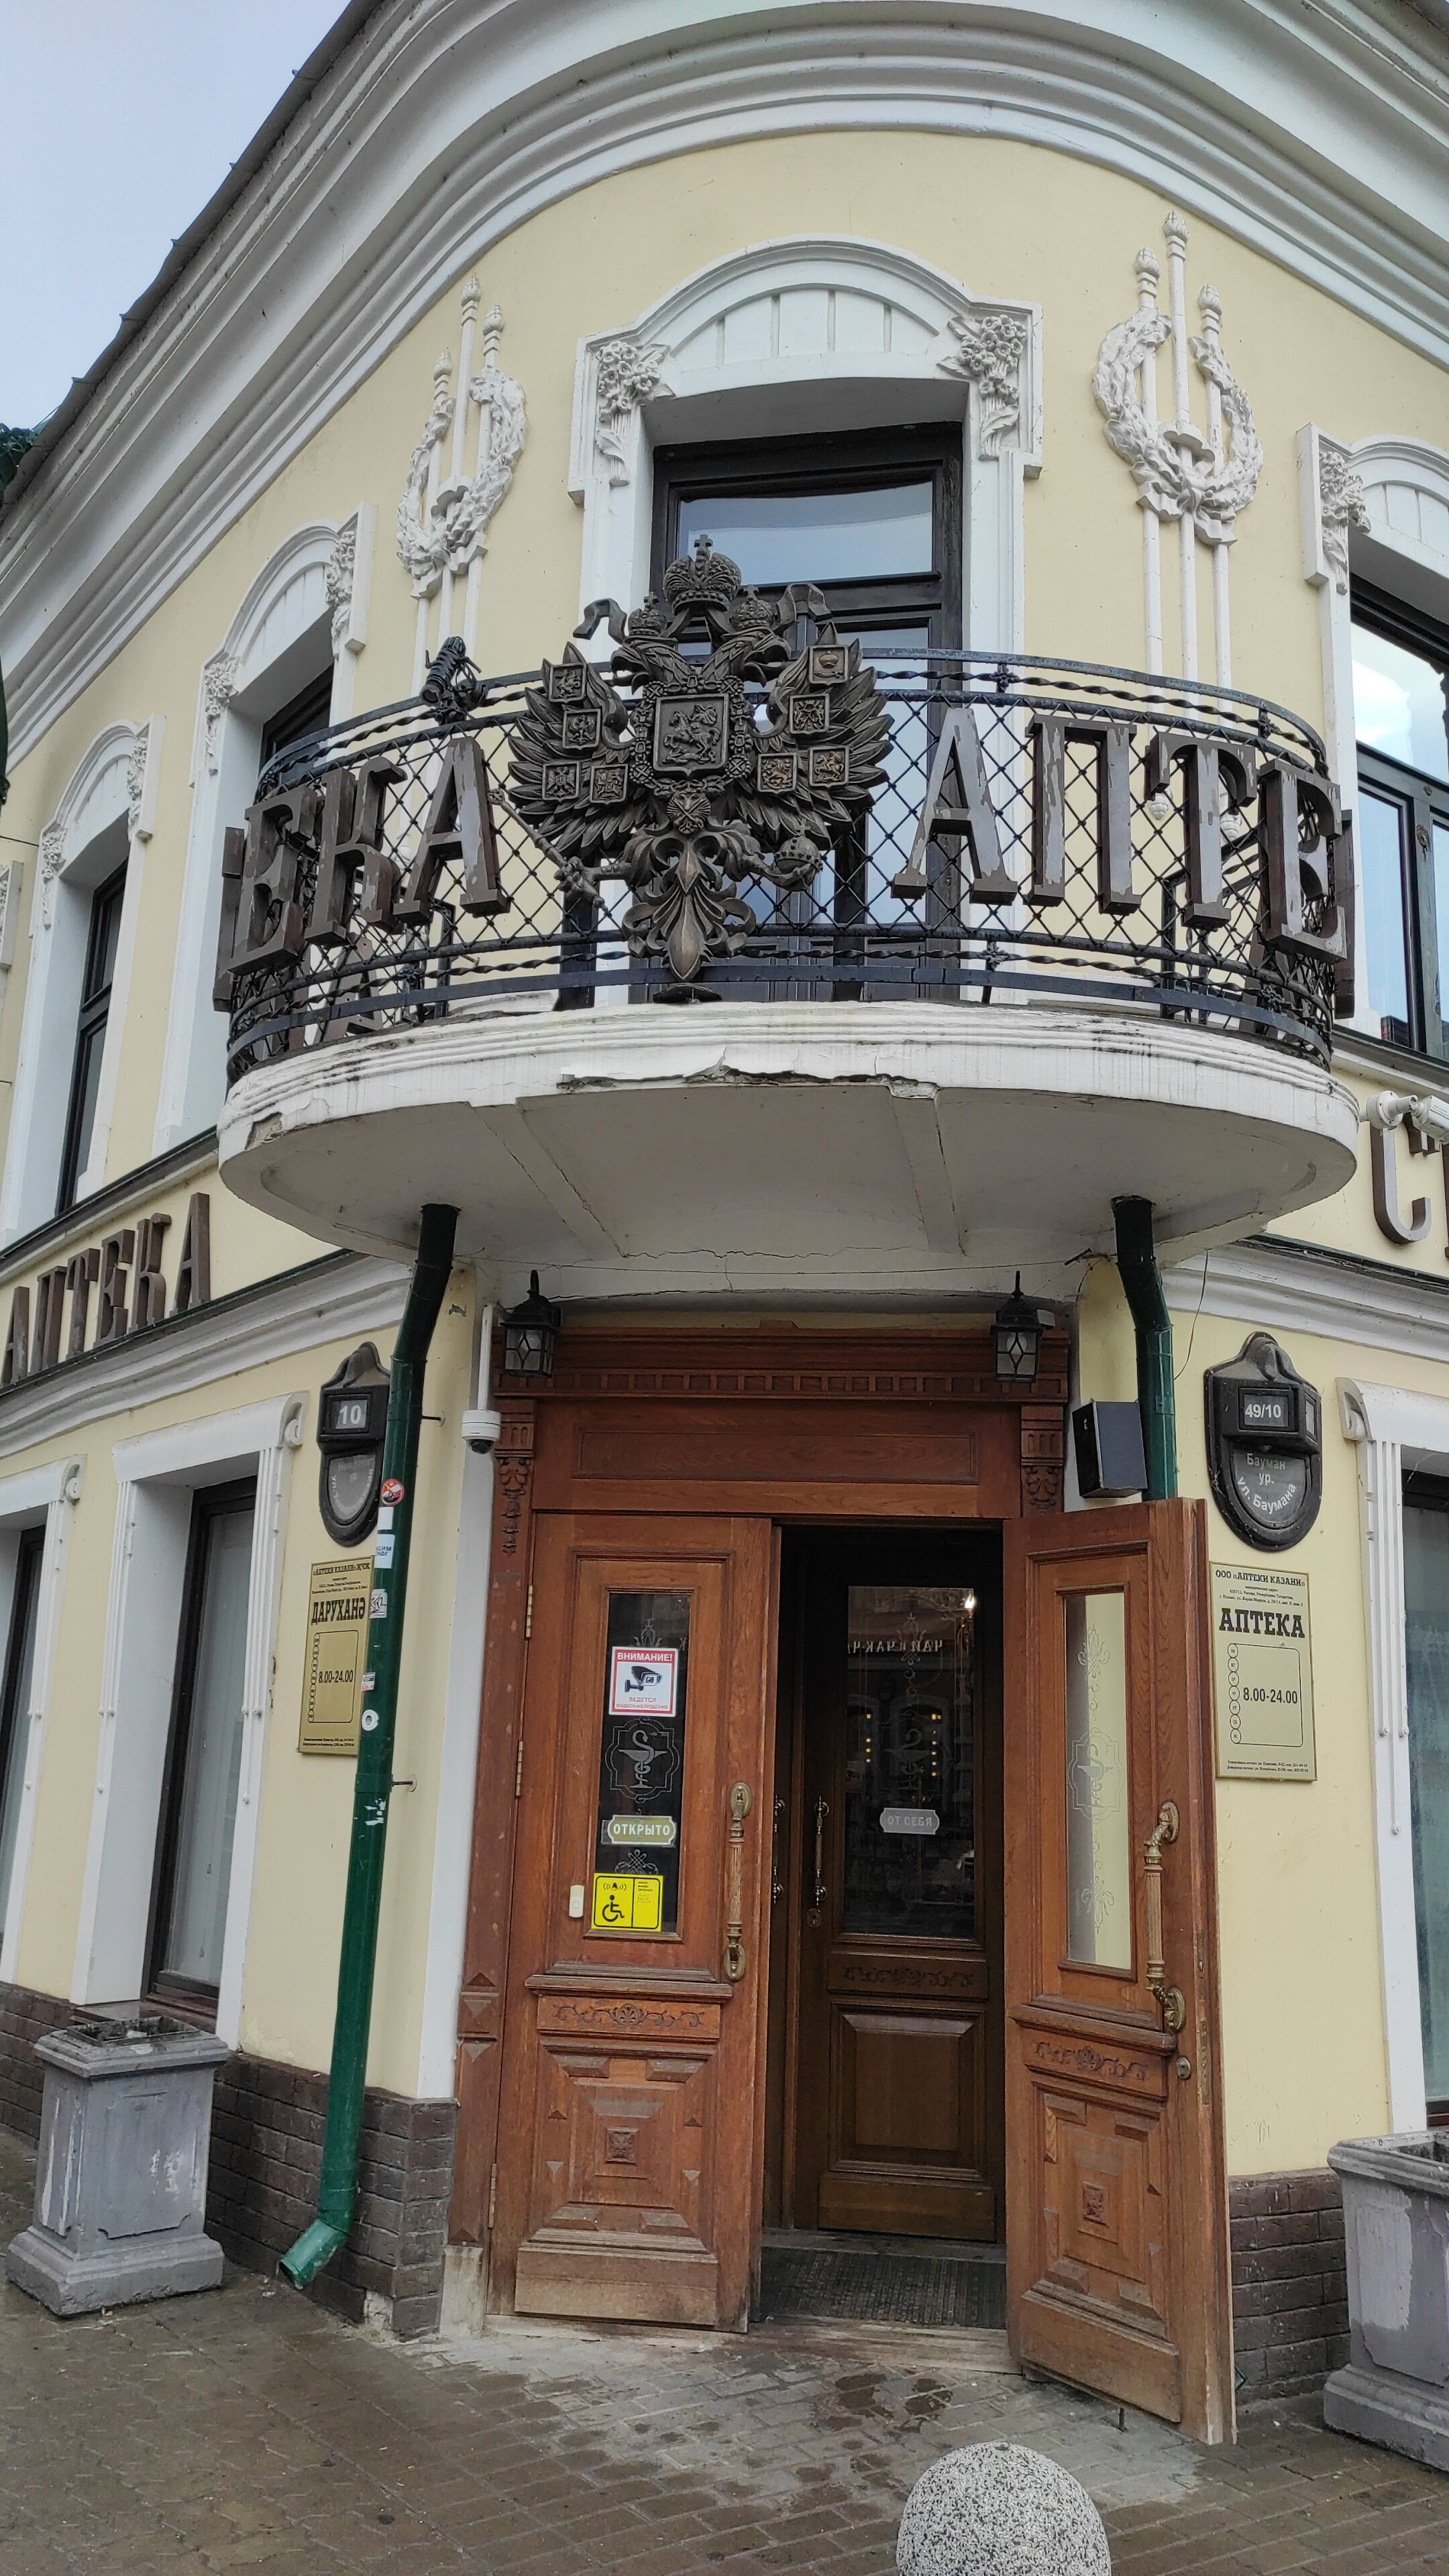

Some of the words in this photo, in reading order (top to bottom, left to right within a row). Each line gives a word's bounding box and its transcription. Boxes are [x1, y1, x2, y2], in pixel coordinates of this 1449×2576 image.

[892, 707, 1354, 1019] АПТЕ
[213, 737, 511, 1012] ЕКА
[1, 1192, 211, 1387] АПТЕКА
[339, 1405, 361, 1425] 10
[1244, 1404, 1281, 1419] 49/10
[1246, 1453, 1286, 1470] Бауман
[1258, 1472, 1275, 1486] ур.
[1237, 1476, 1251, 1501] ул.
[1252, 1483, 1297, 1515] Баумана
[1216, 1570, 1232, 1579] ООО
[1233, 1572, 1269, 1583] «АПТЕКИ
[1270, 1576, 1305, 1587] КАЗАНИ»
[311, 1597, 366, 1625] ДАРУХАНӘ
[1219, 1608, 1305, 1638] АПТЕКА
[617, 1652, 673, 1662] ВНИМАНИЕ!
[318, 1669, 354, 1684] 8.00-24.00
[1243, 1688, 1298, 1704] 8.00-24.00
[888, 1815, 900, 1825] ОТ
[904, 1816, 932, 1827] СЕБЯ
[613, 1823, 670, 1837] ОТКРЫТО
